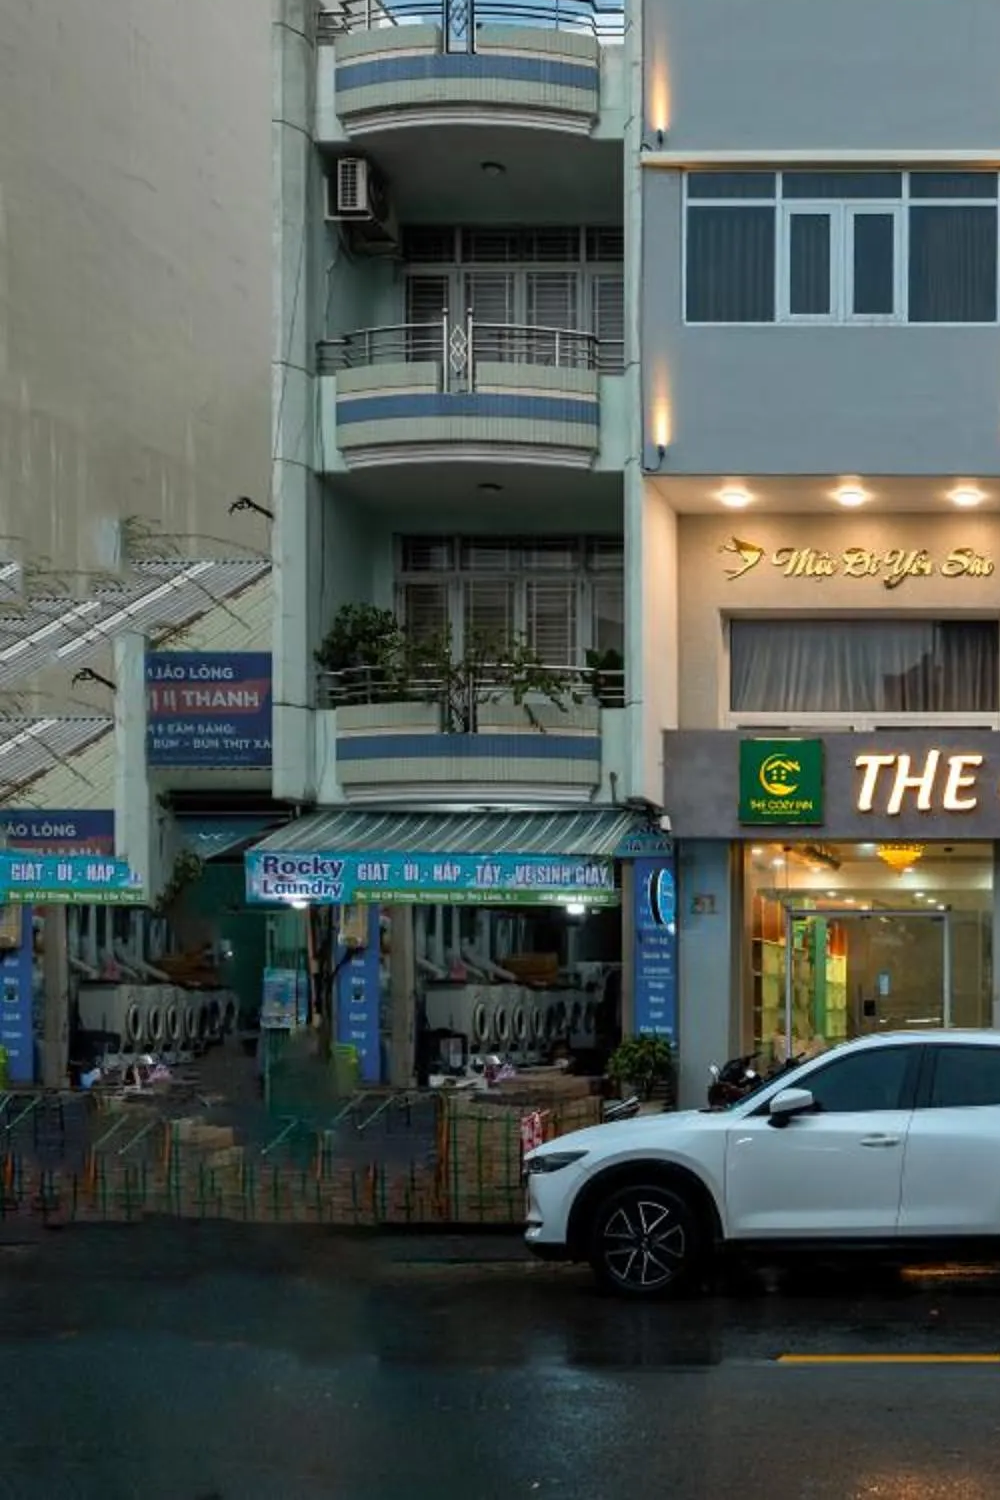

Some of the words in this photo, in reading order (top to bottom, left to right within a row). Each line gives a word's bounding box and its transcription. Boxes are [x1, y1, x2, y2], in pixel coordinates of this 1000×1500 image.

[854, 749, 984, 815] THE
[262, 855, 344, 879] Rocky
[262, 879, 344, 897] Laundry
